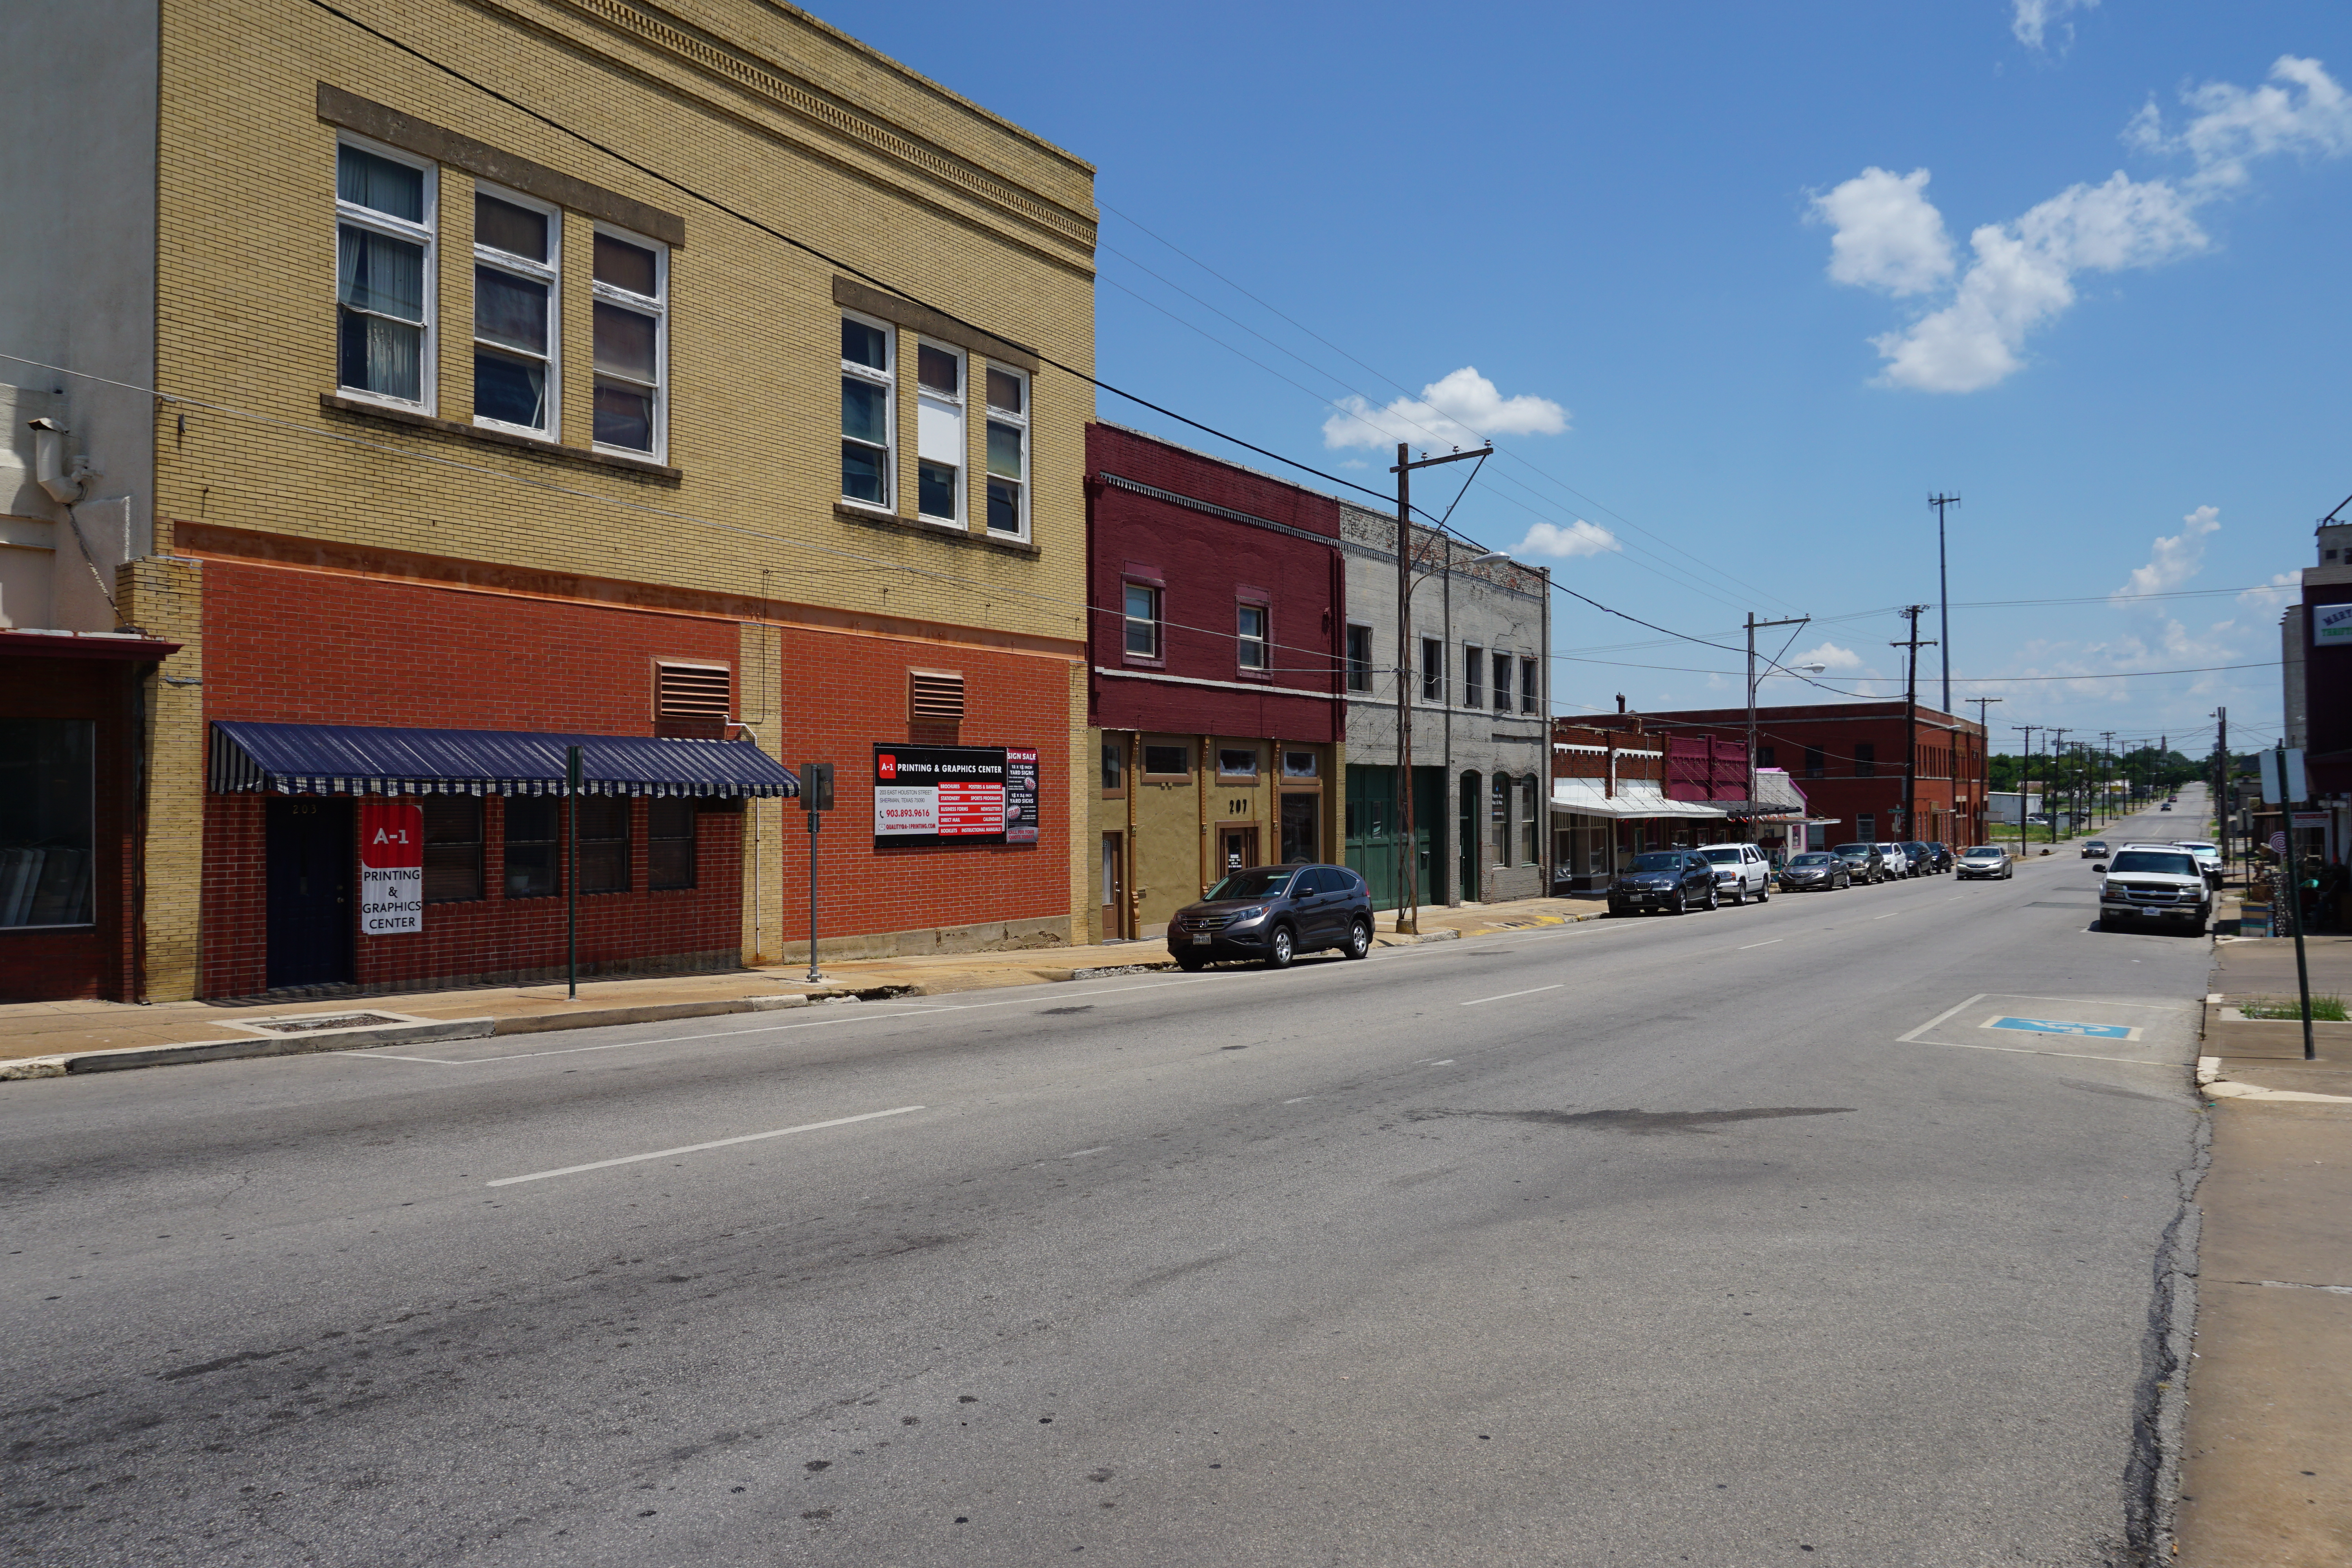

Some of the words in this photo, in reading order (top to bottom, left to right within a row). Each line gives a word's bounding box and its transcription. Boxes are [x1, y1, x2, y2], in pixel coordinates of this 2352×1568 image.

[898, 764, 932, 772] PRINTING
[942, 764, 976, 773] GRAPHICS
[293, 804, 316, 814] 203
[1229, 799, 1247, 813] 207
[886, 809, 930, 817] 903.893.9616
[373, 828, 409, 844] A-1
[364, 870, 420, 881] PRINTING
[388, 887, 398, 898] &
[363, 901, 421, 913] GRAPHICS
[369, 917, 415, 929] CENTER
